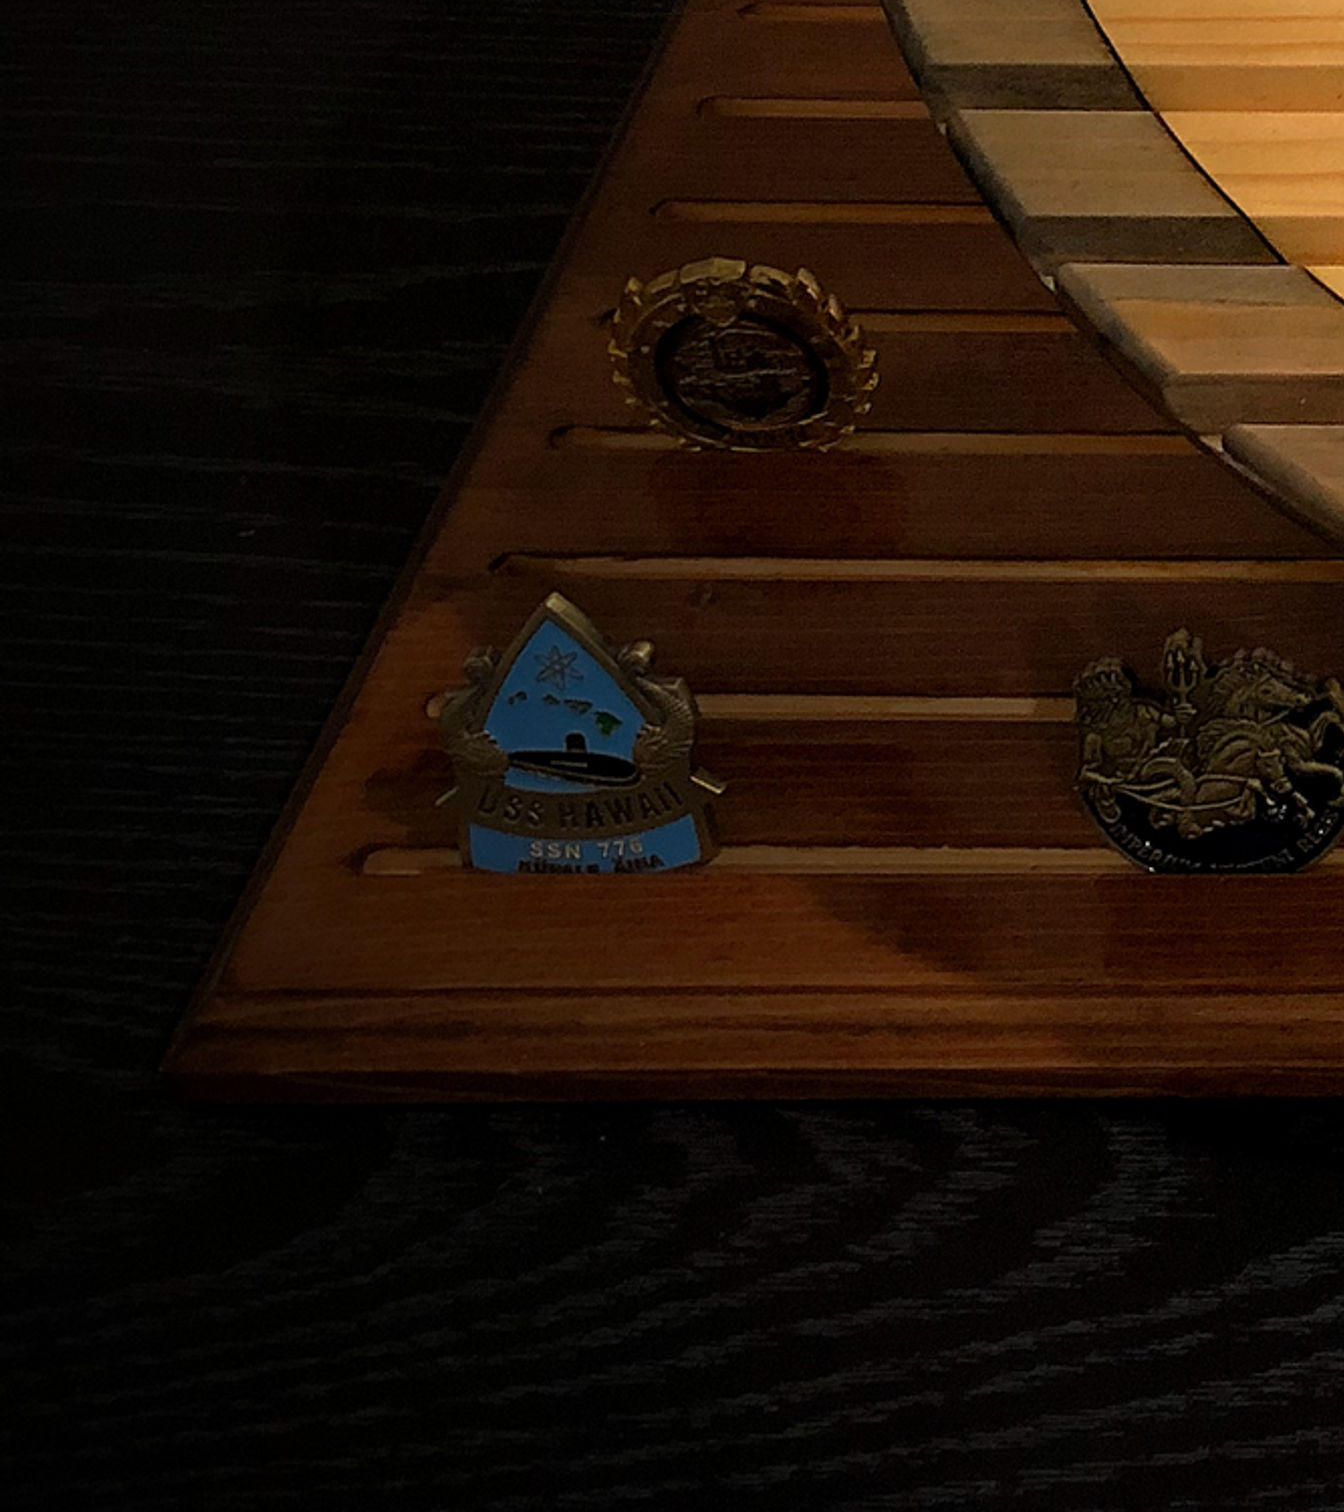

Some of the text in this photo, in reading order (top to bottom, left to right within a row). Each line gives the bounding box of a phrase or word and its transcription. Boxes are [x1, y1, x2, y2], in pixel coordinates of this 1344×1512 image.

[476, 781, 684, 829] USS HAWAII
[529, 838, 643, 860] SSN 776
